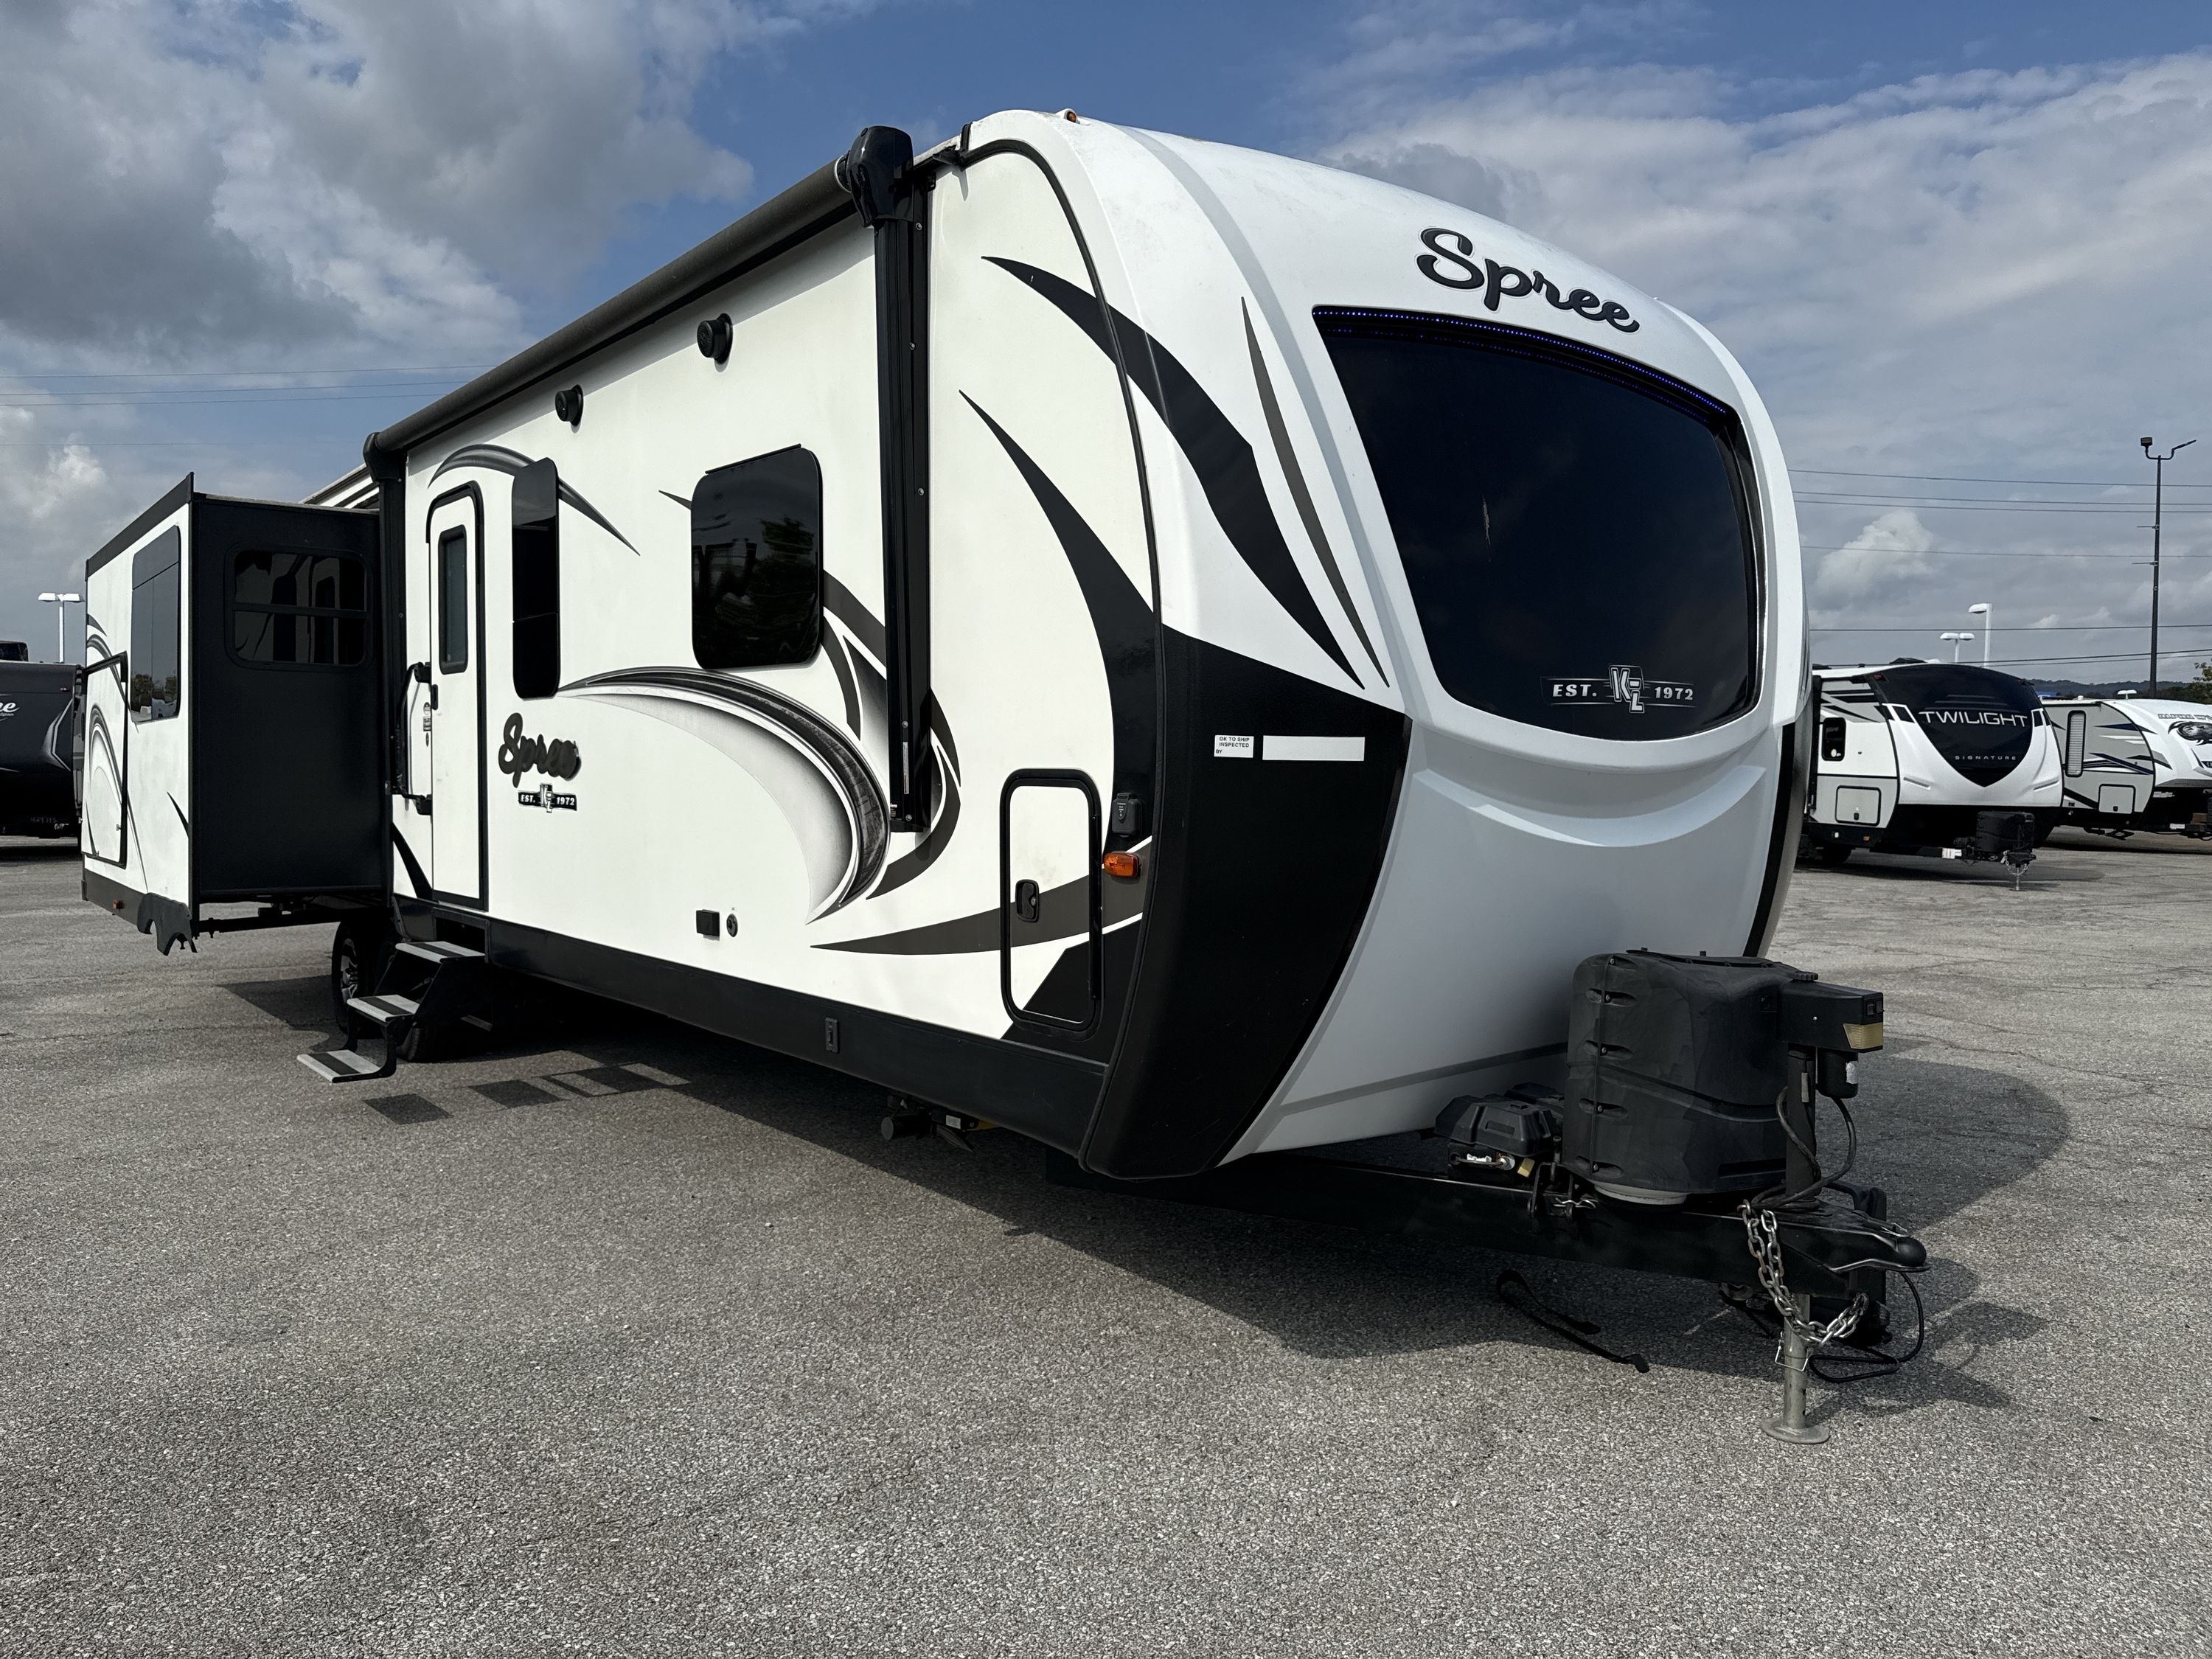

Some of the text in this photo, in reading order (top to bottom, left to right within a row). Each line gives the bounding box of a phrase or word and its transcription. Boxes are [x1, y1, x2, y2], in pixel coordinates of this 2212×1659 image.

[1416, 227, 1641, 333] Spree
[1552, 684, 1597, 698] EST.
[1654, 686, 1694, 700] 1972
[1918, 711, 2028, 728] TWILIGHT
[521, 794, 536, 803] EST.
[556, 796, 575, 806] 1972
